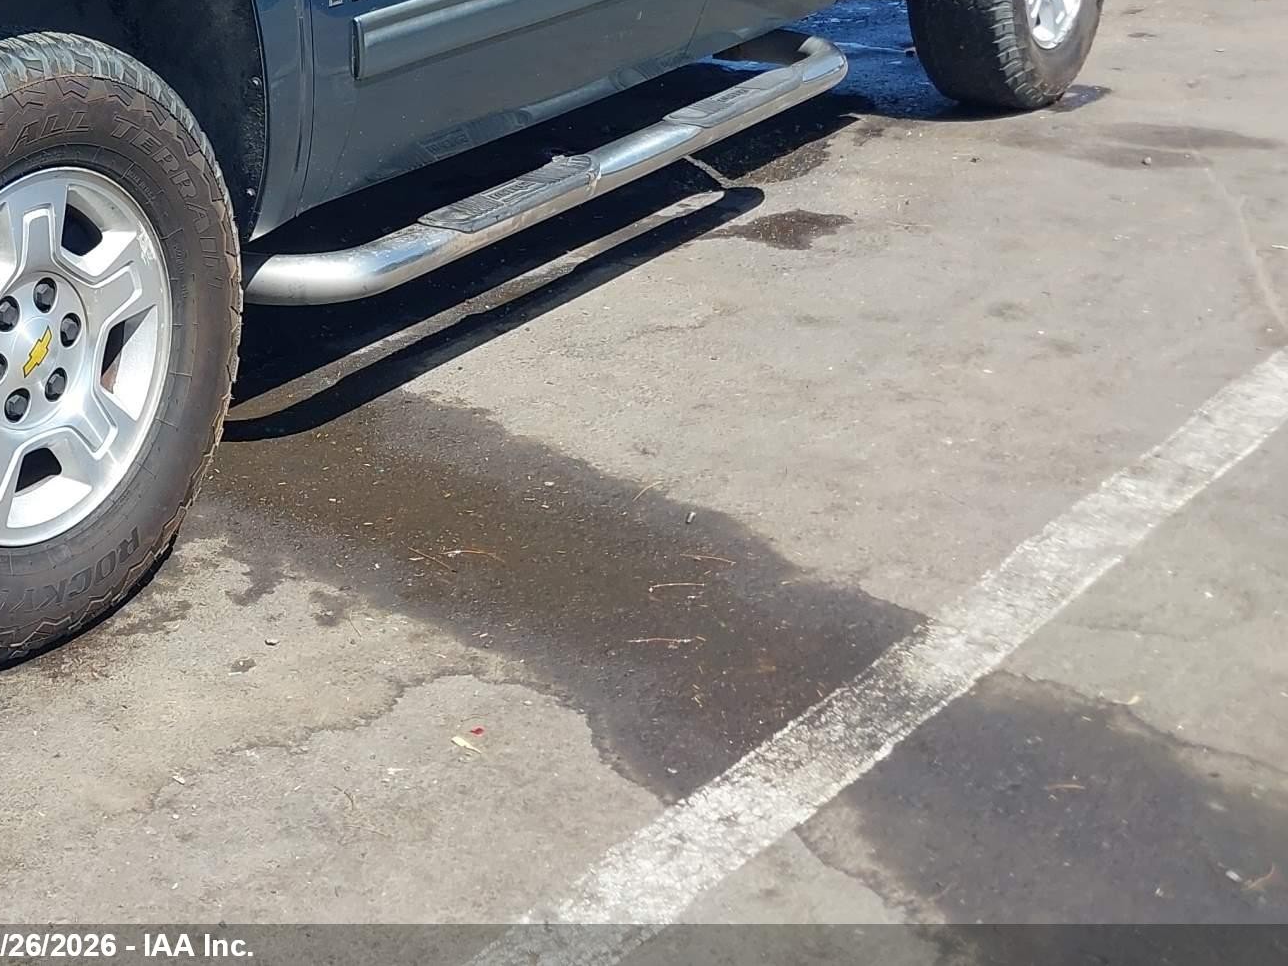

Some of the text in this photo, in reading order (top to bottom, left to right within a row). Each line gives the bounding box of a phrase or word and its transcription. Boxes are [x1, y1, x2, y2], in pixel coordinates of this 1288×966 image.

[8, 111, 90, 156] ALL
[110, 114, 226, 291] TERRAIN
[10, 525, 142, 614] ROCKY
